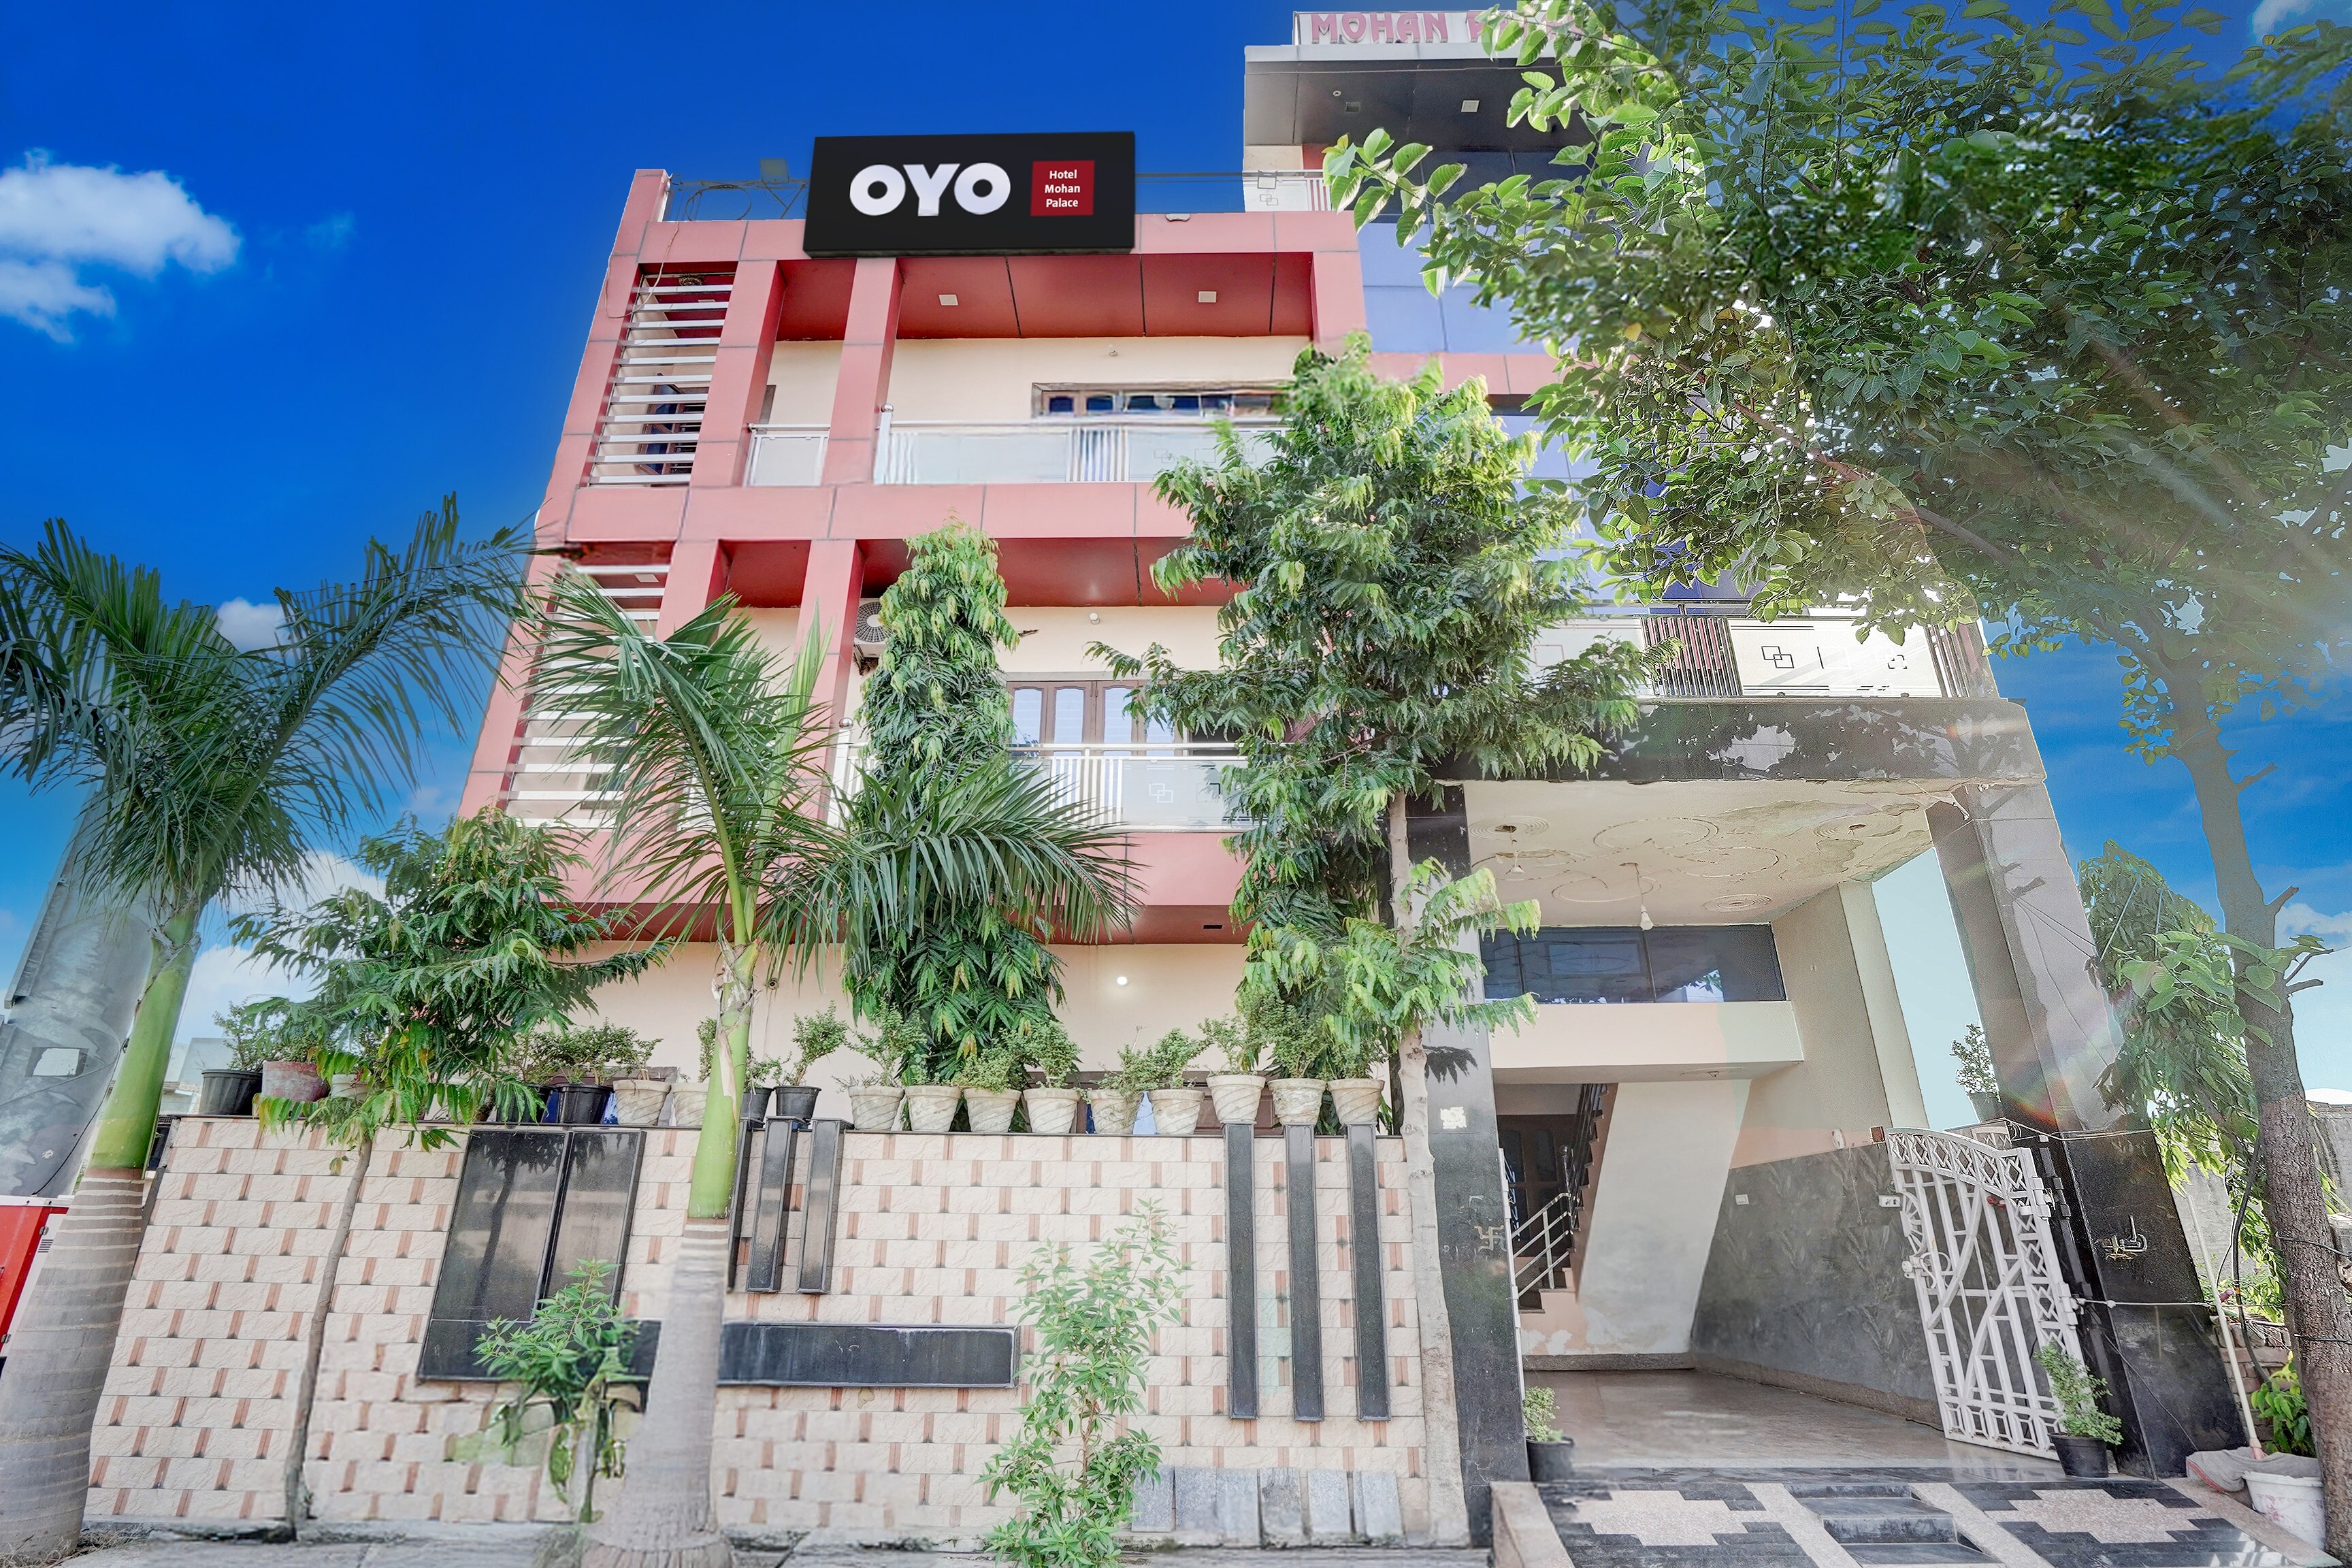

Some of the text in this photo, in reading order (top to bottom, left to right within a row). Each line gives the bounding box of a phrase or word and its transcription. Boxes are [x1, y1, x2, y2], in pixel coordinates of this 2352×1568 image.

[1310, 12, 1448, 44] MOHAN
[1049, 169, 1077, 179] Hotel
[849, 162, 1011, 216] OYO
[1045, 183, 1081, 193] Mohan
[1046, 197, 1079, 208] Palace
